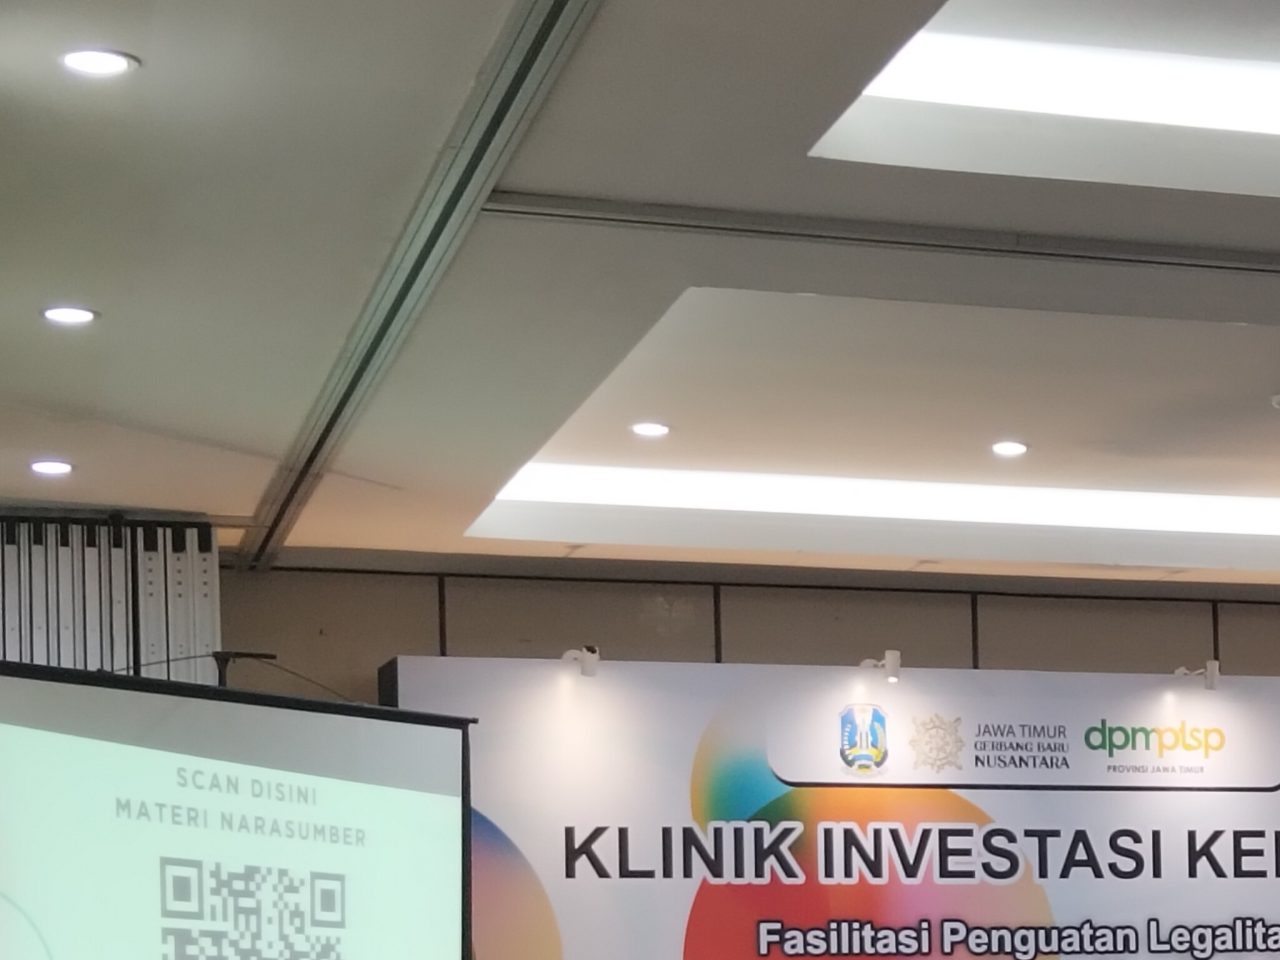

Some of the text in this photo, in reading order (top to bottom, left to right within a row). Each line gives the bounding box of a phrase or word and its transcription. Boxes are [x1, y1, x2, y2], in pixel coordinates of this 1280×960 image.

[974, 724, 1067, 739] JAWA TIMUR
[973, 741, 1070, 753] GERBANG BARU
[973, 754, 1070, 769] NUSANTARA
[1106, 764, 1205, 774] PROVINSI JAWA TIMUR
[176, 766, 318, 806] SCAN DISINI
[114, 796, 367, 848] MATERI NARASUMBER
[563, 825, 800, 880] KLINIK
[822, 826, 1162, 880] INVESTASI
[757, 921, 931, 955] Fasilitasi
[942, 920, 1138, 960] Penguatan
